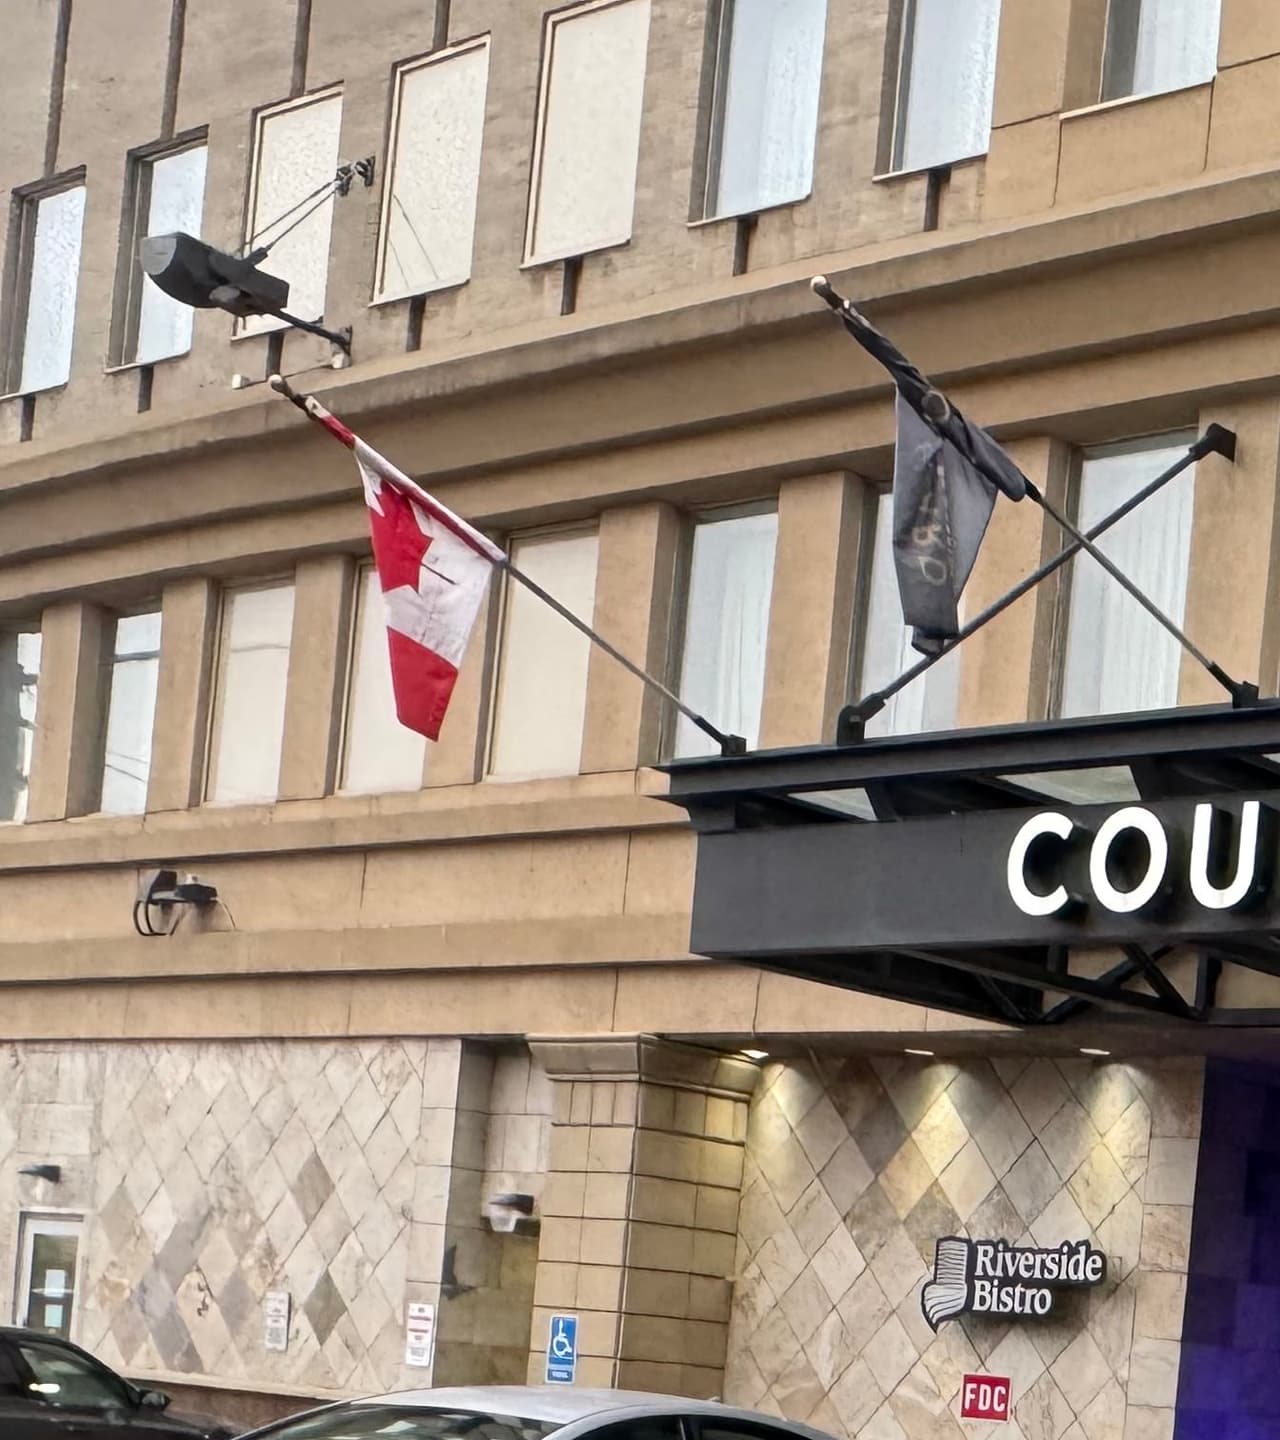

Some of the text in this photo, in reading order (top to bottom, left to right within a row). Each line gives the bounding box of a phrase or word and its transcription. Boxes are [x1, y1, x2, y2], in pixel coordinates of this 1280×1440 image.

[974, 1243, 1103, 1281] Riverside
[972, 1279, 1053, 1315] Bistro
[963, 1382, 1007, 1413] FDC
